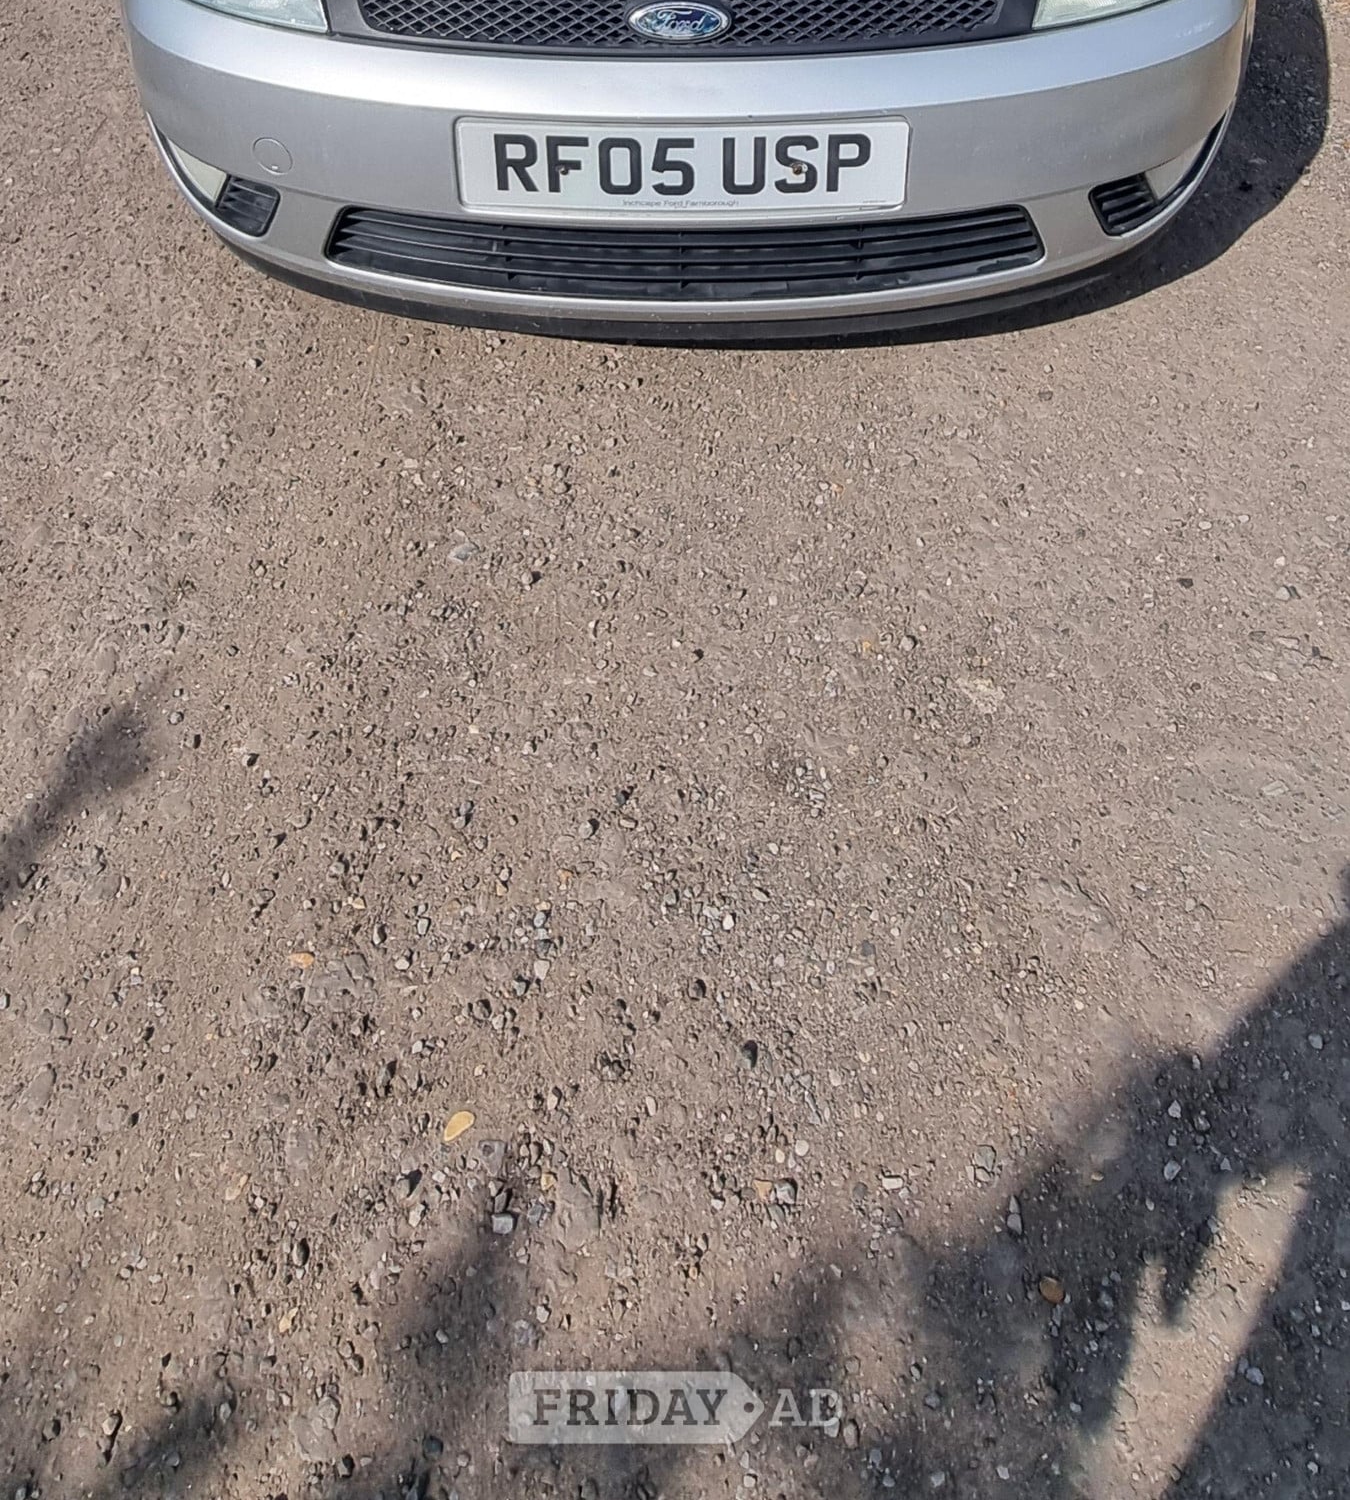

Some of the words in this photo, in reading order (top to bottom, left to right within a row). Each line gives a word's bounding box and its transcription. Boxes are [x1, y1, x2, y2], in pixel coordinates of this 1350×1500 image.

[653, 9, 707, 31] Ford
[493, 133, 695, 196] RF05
[722, 133, 871, 195] USP
